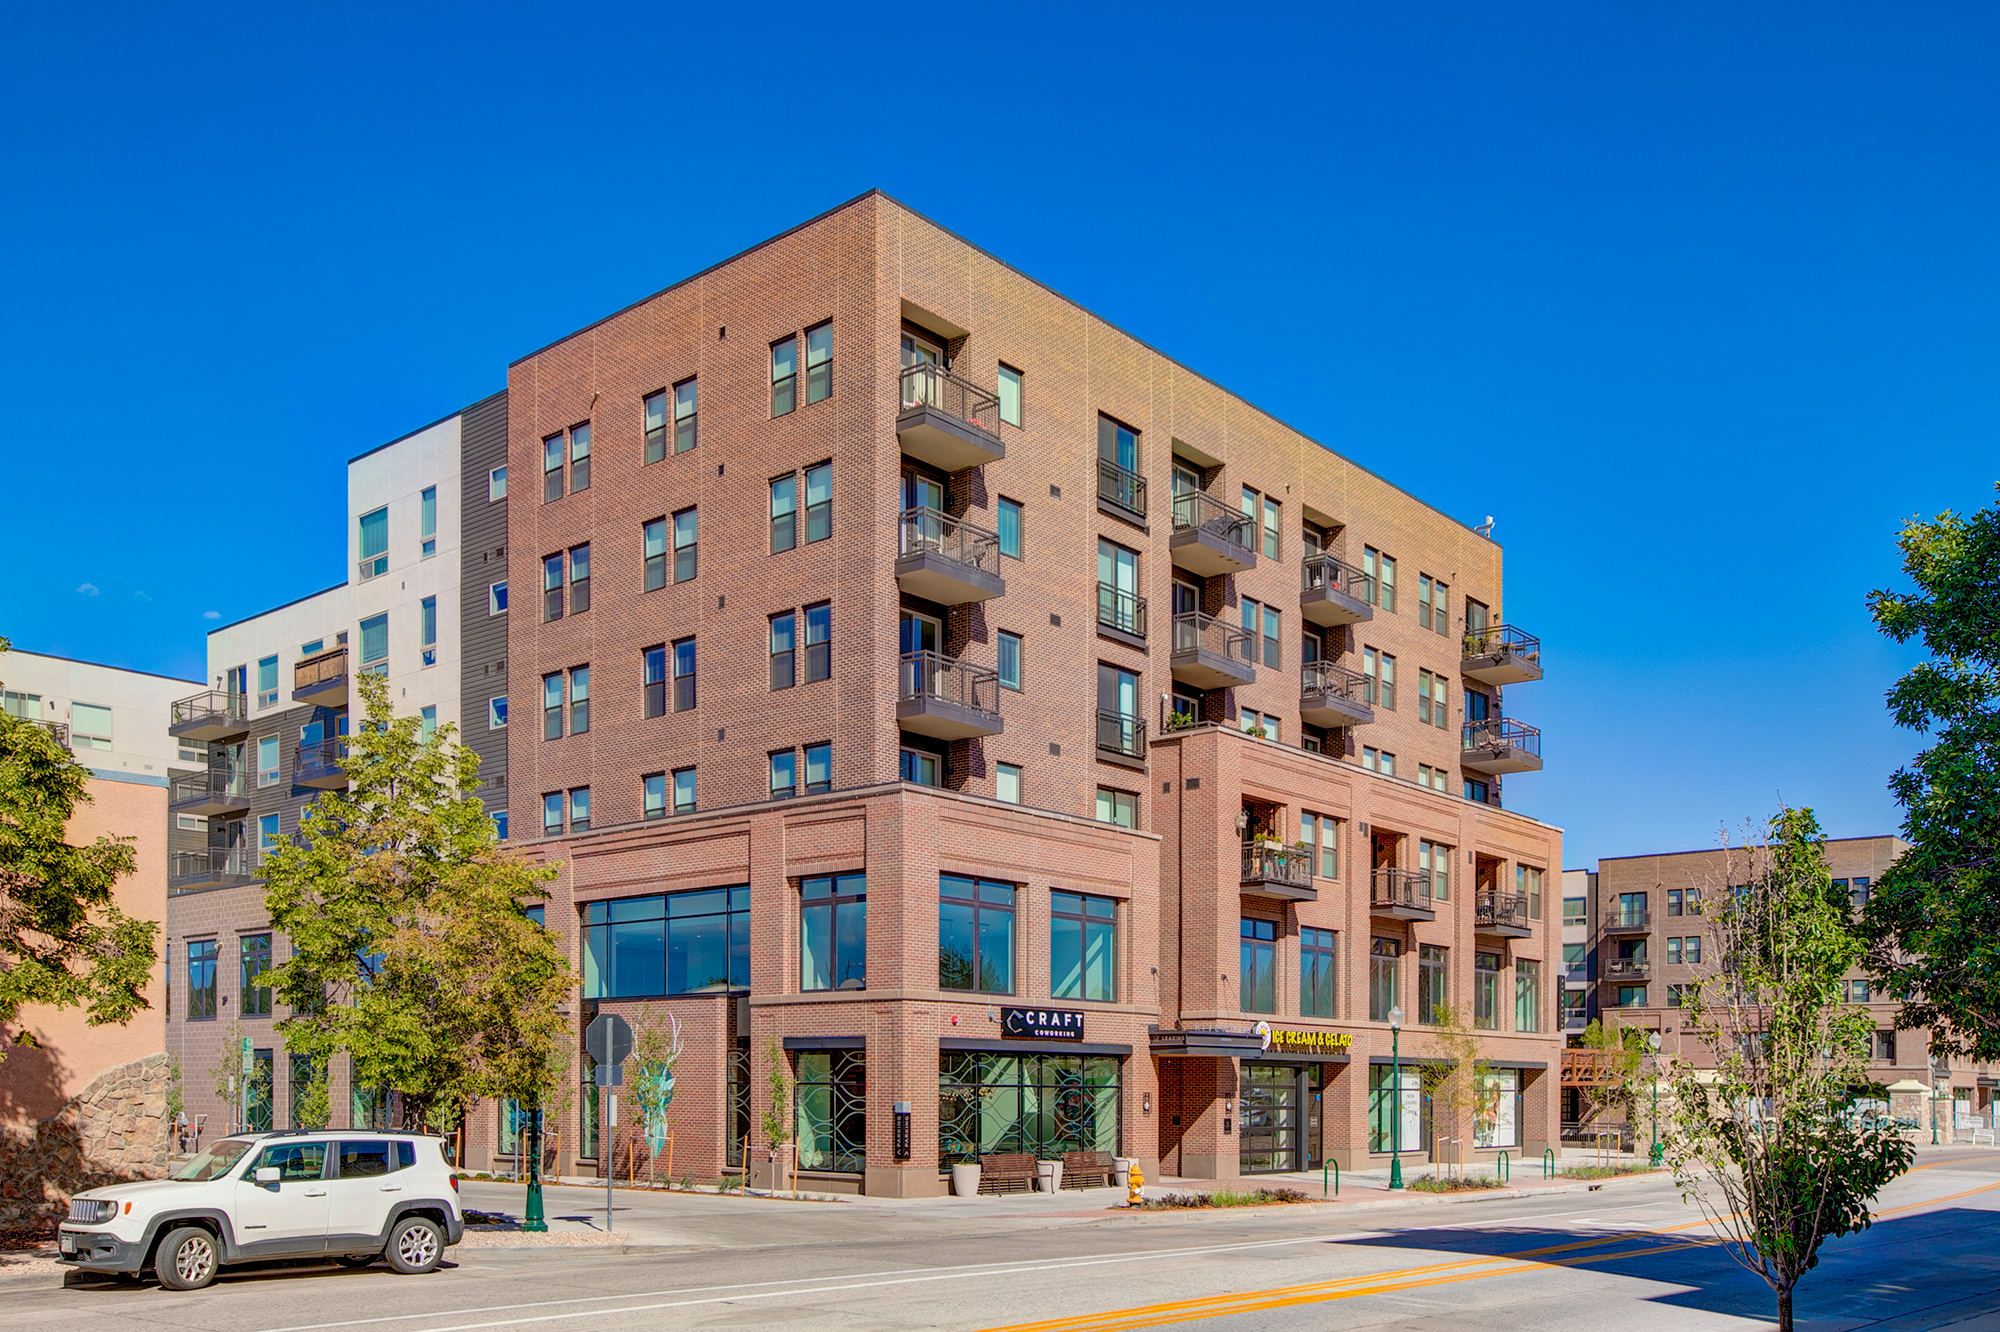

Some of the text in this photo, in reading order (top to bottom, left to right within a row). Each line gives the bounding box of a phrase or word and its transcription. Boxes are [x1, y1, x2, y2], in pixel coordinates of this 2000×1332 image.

[1026, 1011, 1083, 1028] CRAFT
[1034, 1029, 1075, 1038] COWORKING
[1272, 1030, 1352, 1047] ICE CREAM & GELATO
